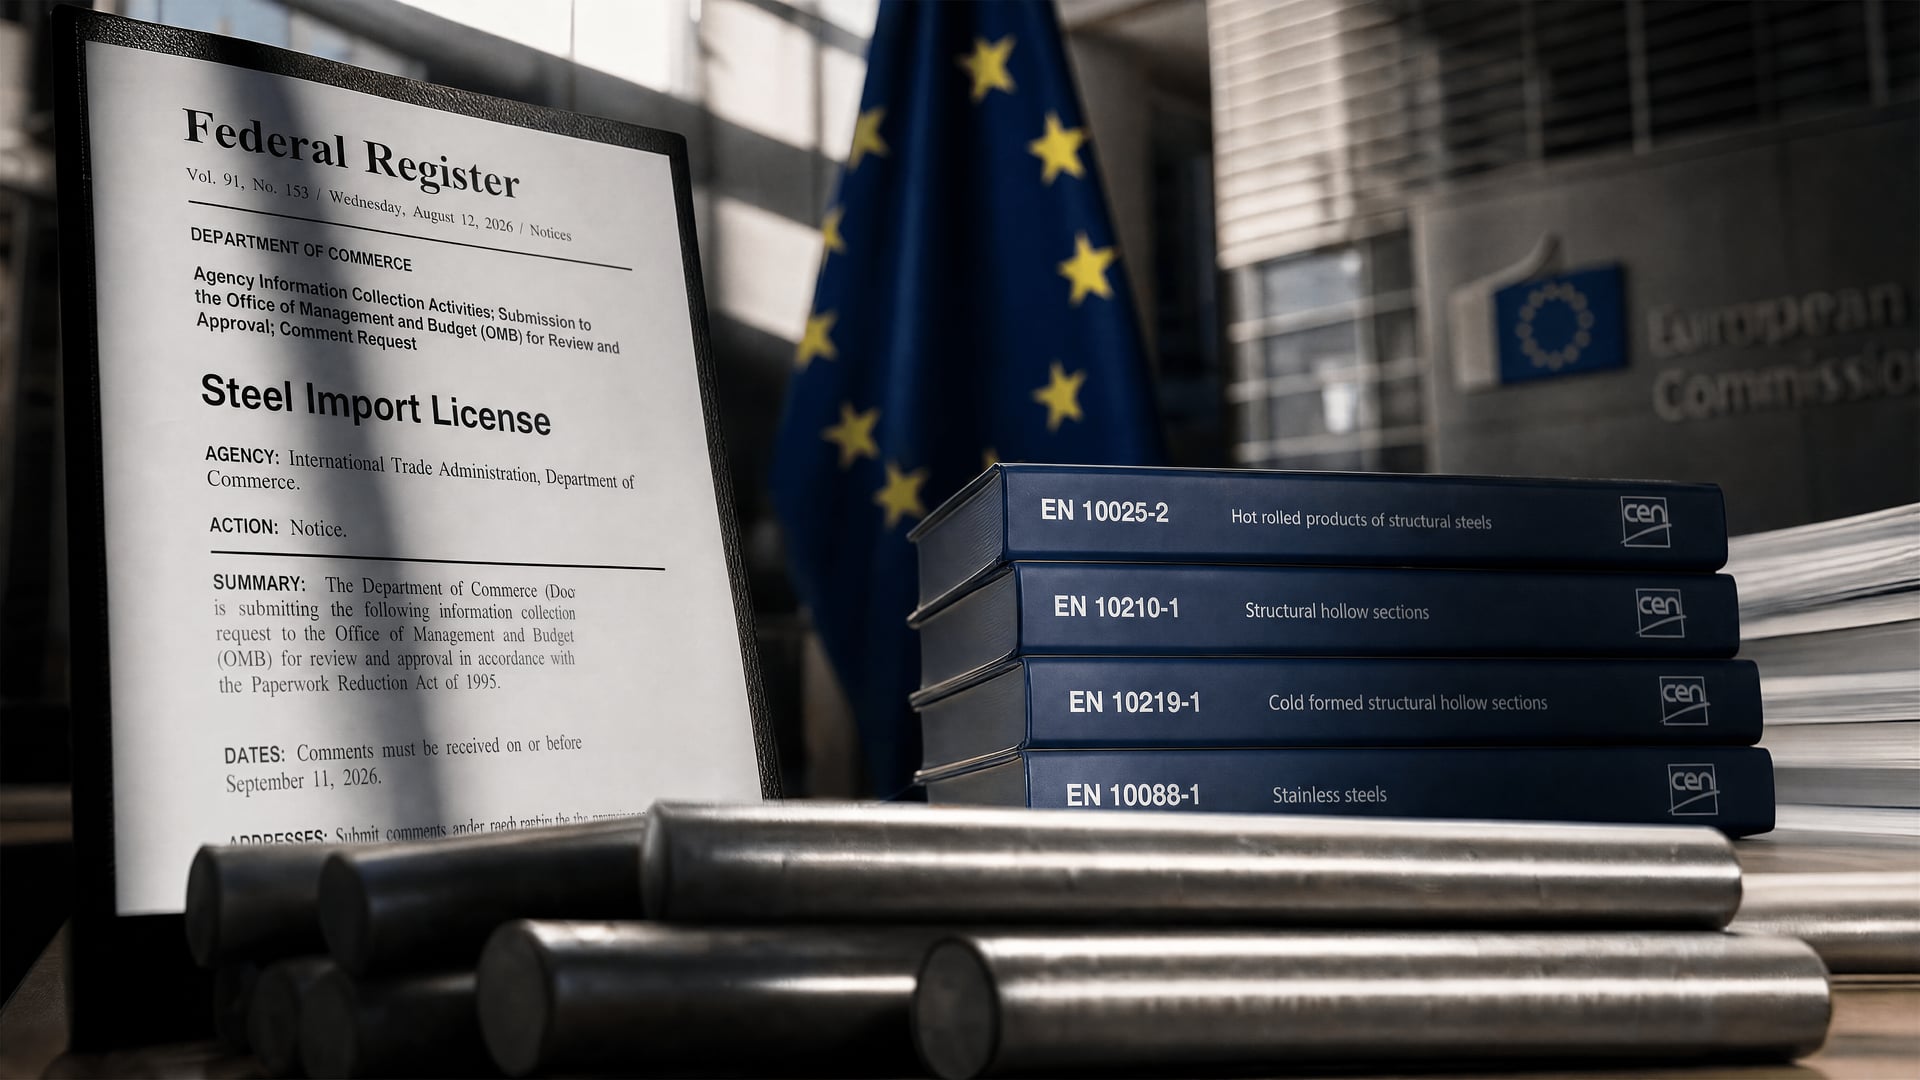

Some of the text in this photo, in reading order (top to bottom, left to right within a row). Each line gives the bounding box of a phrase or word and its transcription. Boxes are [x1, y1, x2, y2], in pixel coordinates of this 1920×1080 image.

[182, 108, 520, 199] Federal Register
[186, 167, 572, 241] Vol. 91, No. 153 / Wednesday, August 12, 2026 / Notices
[191, 226, 413, 272] DEPARTMENT OF COMMERCE
[194, 266, 592, 331] Agency Information Collection Activities; Submission to
[194, 289, 620, 354] the Office of Management and Budget (OMB) for Review and
[1649, 282, 1905, 355] European
[196, 311, 418, 351] Approval; Comment Request
[201, 373, 551, 436] Steel Import License
[205, 445, 635, 490] AGENCY: International Trade Administration, Department of
[207, 469, 300, 490] Commerce.
[1041, 498, 1169, 523] EN 10025-2
[1232, 508, 1492, 530] Hot rolled products of structural steels
[1624, 503, 1666, 523] cen
[210, 517, 347, 538] ACTION: Notice.
[213, 573, 306, 592] SUMMARY:
[325, 576, 354, 593] The
[362, 577, 443, 599] Department
[450, 580, 464, 596] of
[471, 581, 537, 598] Commerce
[215, 599, 576, 623] is submitting the following information collection
[1054, 595, 1179, 618] EN 10210-1
[1245, 602, 1429, 620] Structural hollow sections
[1637, 595, 1680, 614] cen
[216, 625, 574, 646] request to the Office of Management and Budget
[217, 649, 575, 670] (OMB) for review and approval in accordance with
[219, 674, 500, 698] the Paperwork Reduction Act of 1995.
[1662, 683, 1704, 702] cen
[1070, 690, 1200, 713] EN 10219-1
[1269, 694, 1548, 711] Cold formed structural hollow sections
[224, 734, 582, 764] DATES: Comments must be received on or before
[226, 767, 381, 798] September 11, 2026.
[1671, 771, 1714, 791] cen
[1067, 783, 1199, 806] EN 10088-1
[1273, 785, 1387, 803] Stainless steels
[336, 825, 379, 843] Submit
[386, 823, 447, 842] comments
